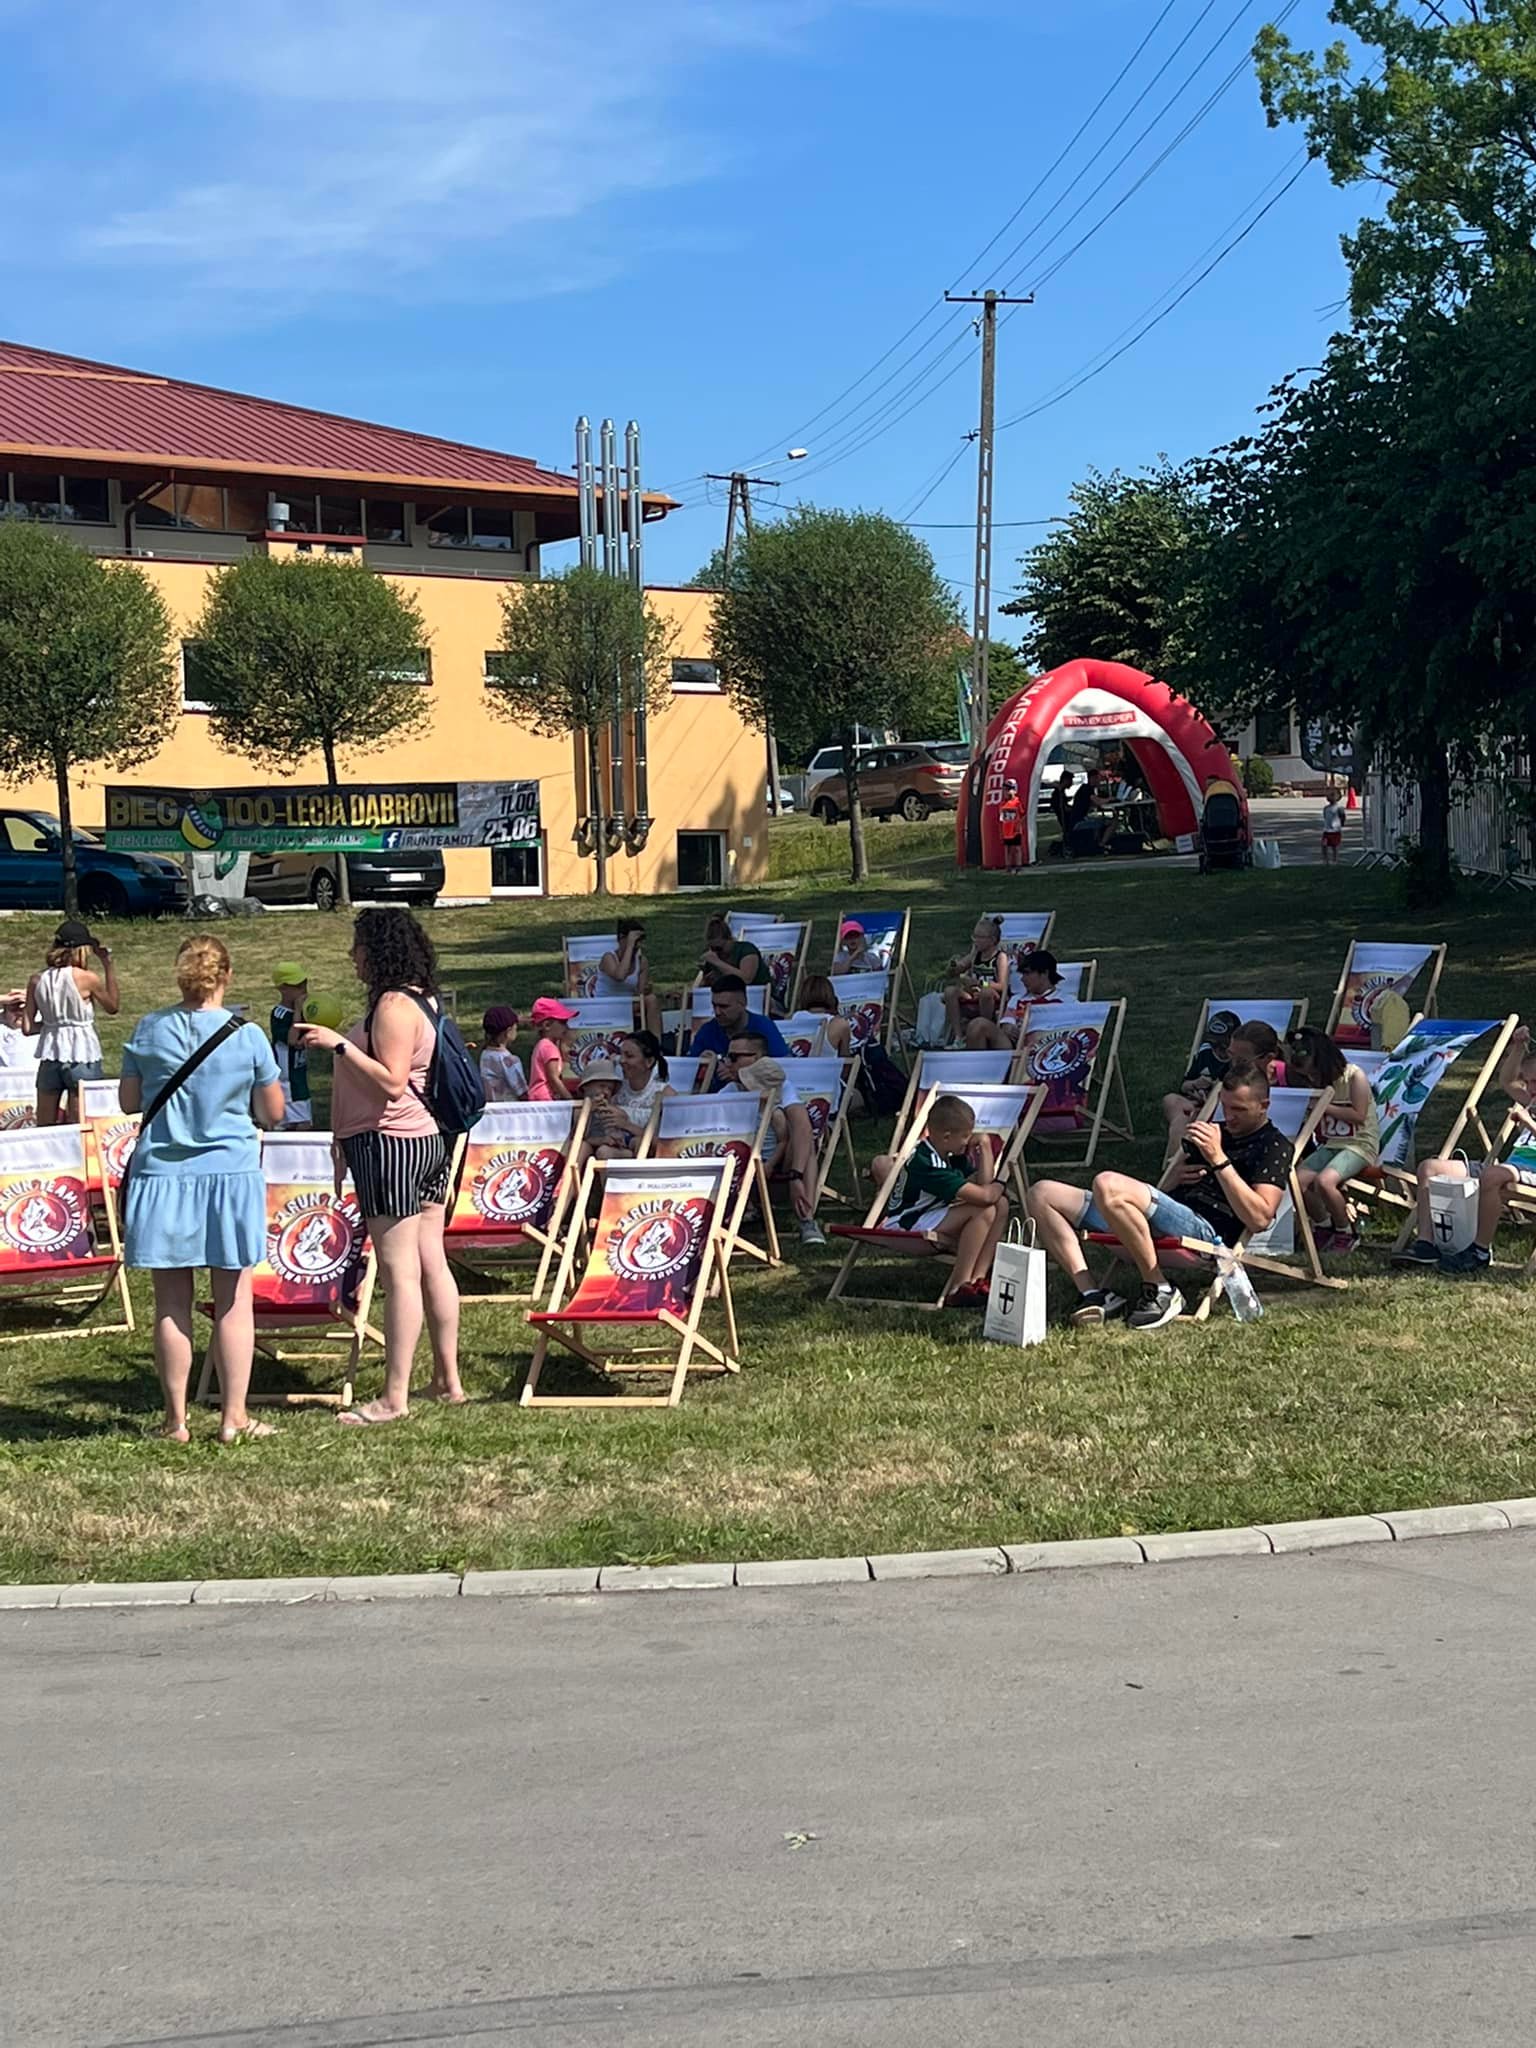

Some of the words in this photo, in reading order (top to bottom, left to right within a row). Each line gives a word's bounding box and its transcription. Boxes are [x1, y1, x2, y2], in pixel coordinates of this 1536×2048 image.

[1067, 713, 1134, 725] TIMEKEEPER
[986, 676, 1054, 806] TIMEKEEPER
[111, 797, 178, 826] BIEG
[351, 792, 455, 834] DĄBROVII
[501, 792, 536, 815] 11.00
[484, 815, 537, 844] 25.06
[40, 1180, 79, 1208] TEAM
[327, 1193, 361, 1228] TEAM
[630, 1200, 664, 1221] RUN
[668, 1199, 706, 1230] TEAM
